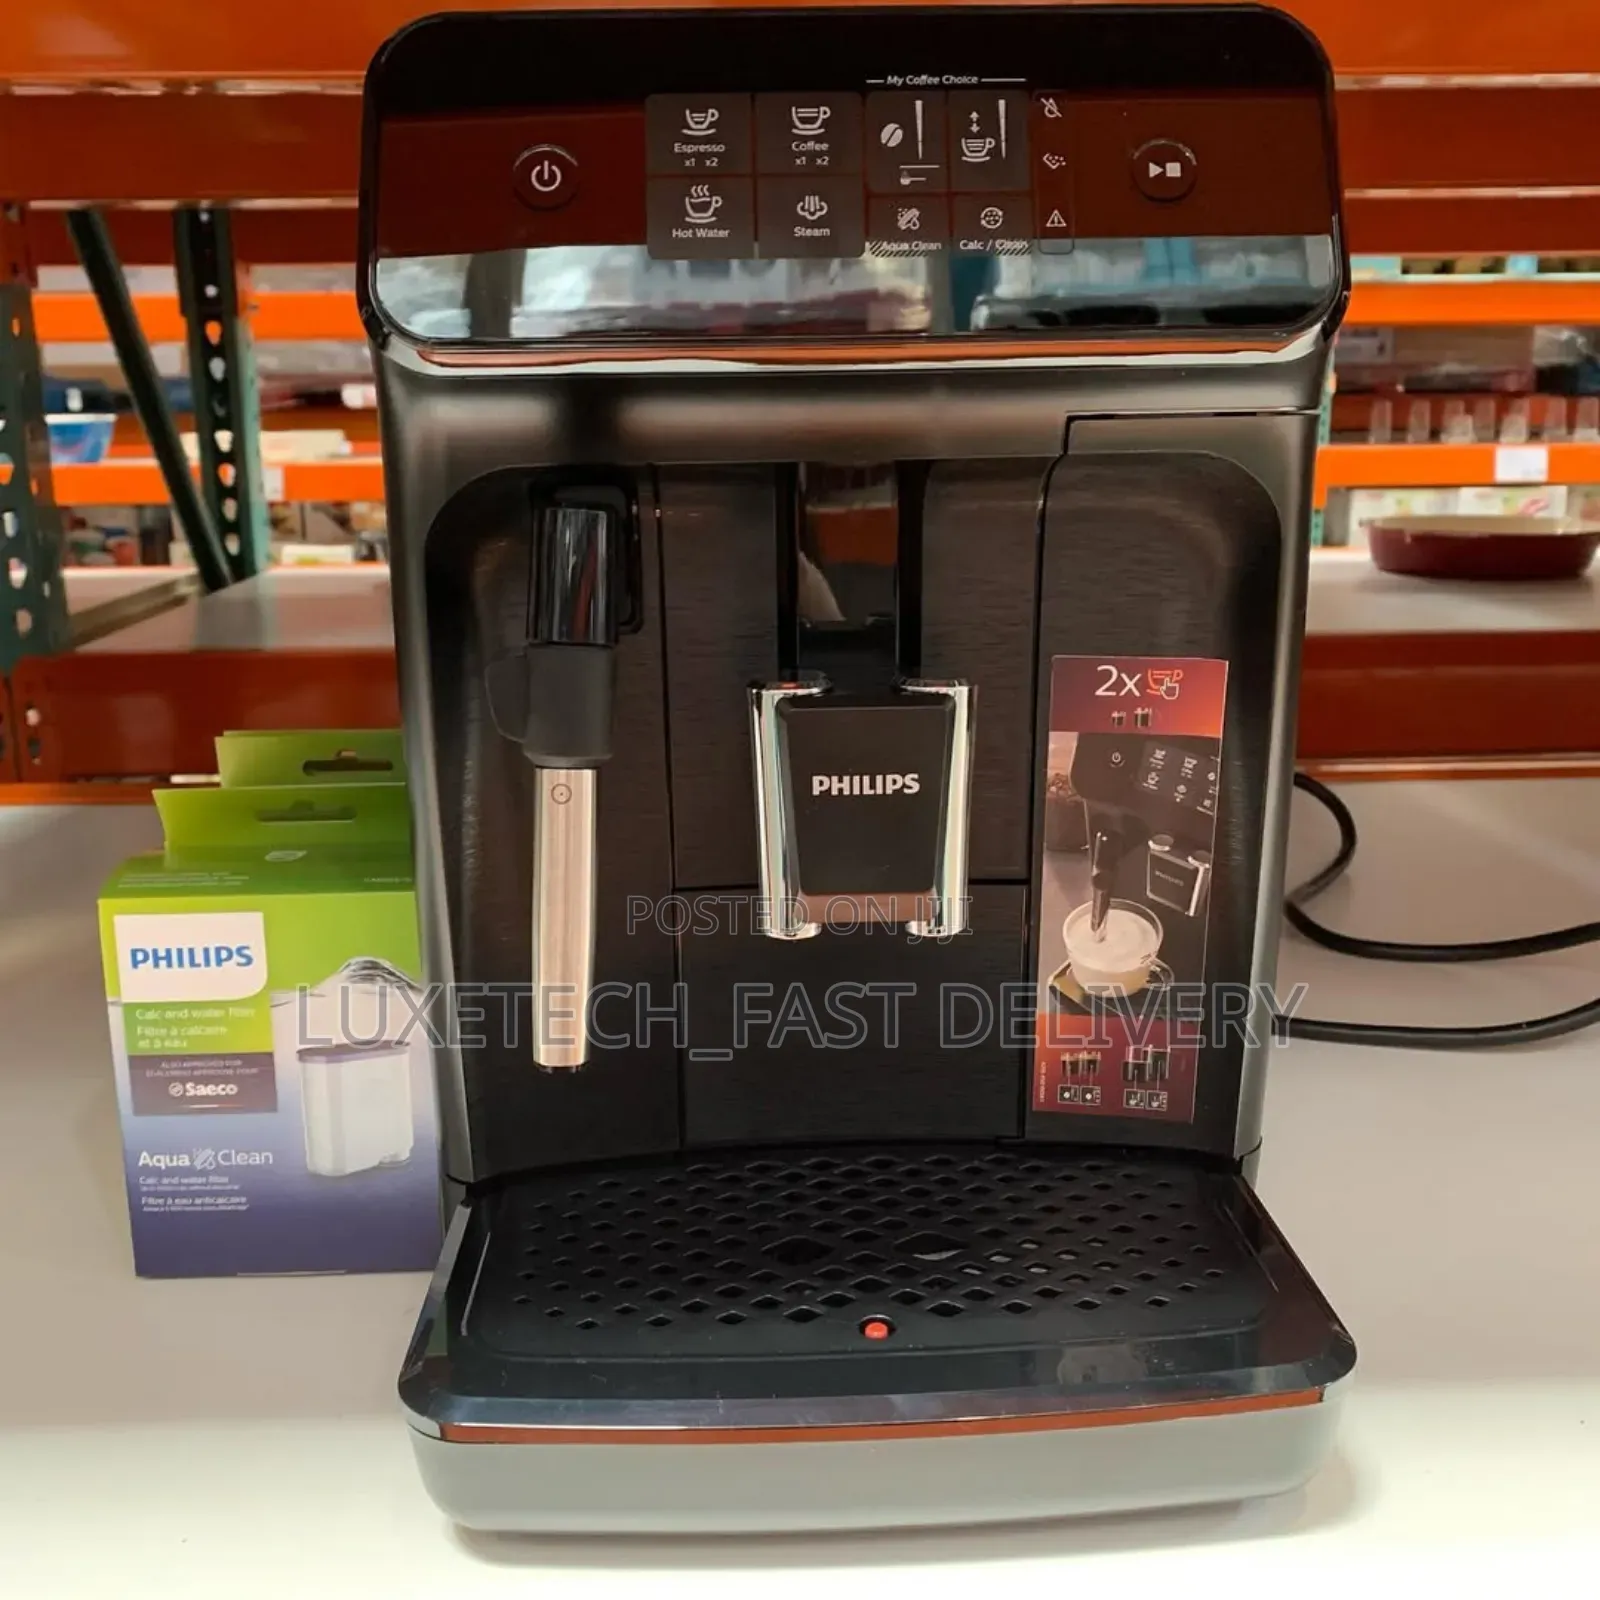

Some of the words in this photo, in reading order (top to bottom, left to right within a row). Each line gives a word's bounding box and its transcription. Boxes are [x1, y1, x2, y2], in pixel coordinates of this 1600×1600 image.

[886, 76, 903, 86] My
[906, 74, 940, 86] Coffee
[942, 74, 979, 84] Choice
[673, 142, 726, 154] Espresso
[791, 141, 829, 151] Coffee
[684, 158, 696, 167] x1
[705, 157, 719, 167] x2
[795, 157, 807, 165] x1
[815, 156, 829, 166] x2
[672, 228, 693, 238] Hot
[695, 228, 730, 238] Water
[793, 226, 831, 237] Steam
[881, 241, 910, 251] Aqua
[959, 240, 984, 250] Calc
[1094, 664, 1142, 697] 2x
[812, 773, 920, 797] PHILIPS
[130, 945, 254, 970] PHILIPS
[163, 1008, 188, 1020] and
[185, 1081, 239, 1097] Saeco
[138, 1150, 191, 1170] Aqua
[217, 1150, 274, 1166] Clean
